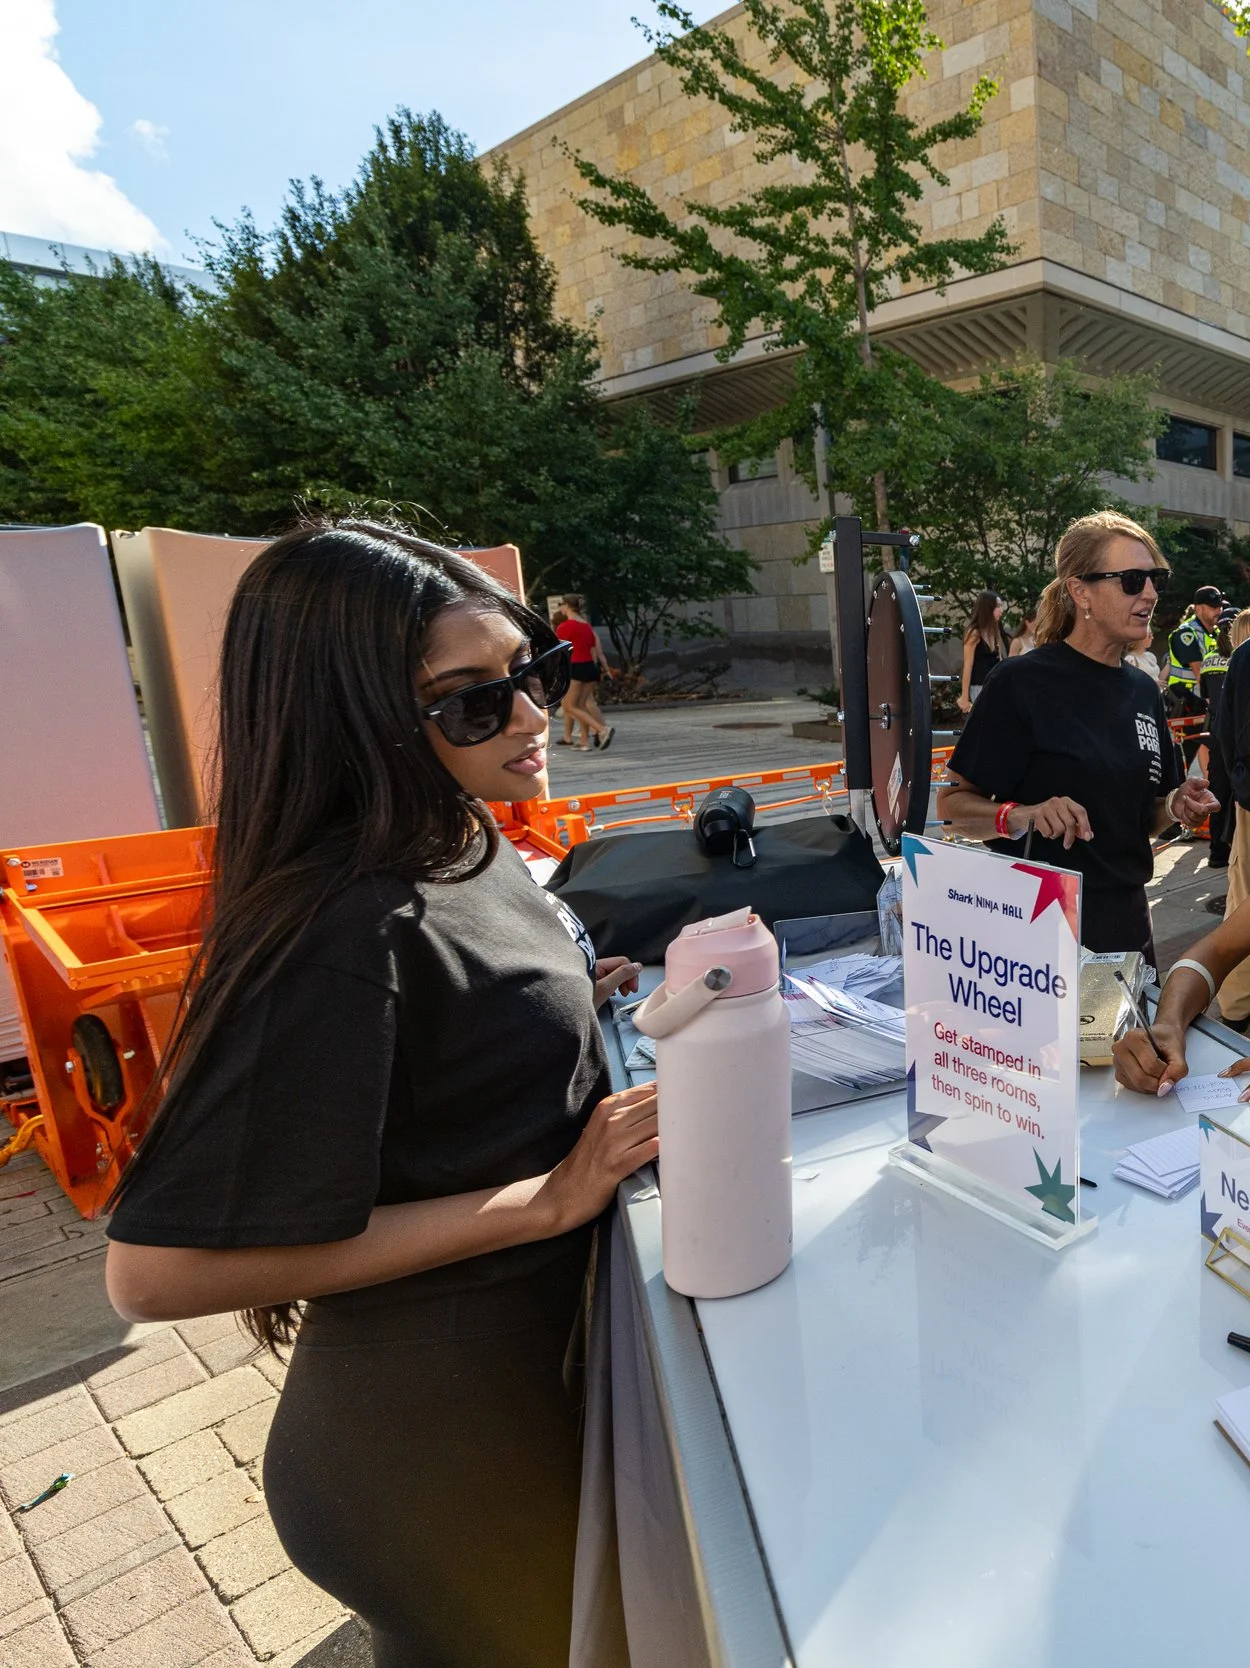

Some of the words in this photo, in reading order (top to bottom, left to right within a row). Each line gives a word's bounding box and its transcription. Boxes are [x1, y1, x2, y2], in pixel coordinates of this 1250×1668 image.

[948, 888, 973, 905] Shark
[1002, 903, 1023, 920] HALL
[911, 921, 952, 961] The
[960, 936, 1067, 999] Upgrade
[948, 973, 1022, 1027] Wheel
[934, 1022, 958, 1046] Get
[961, 1036, 1023, 1072] stamped
[1028, 1059, 1041, 1080] in
[931, 1074, 961, 1101] then
[964, 1095, 993, 1116] spin
[997, 1103, 1012, 1123] to
[1015, 1114, 1045, 1140] win.
[934, 1051, 949, 1069] all
[952, 1056, 987, 1085] three
[991, 1076, 1041, 1112] rooms,
